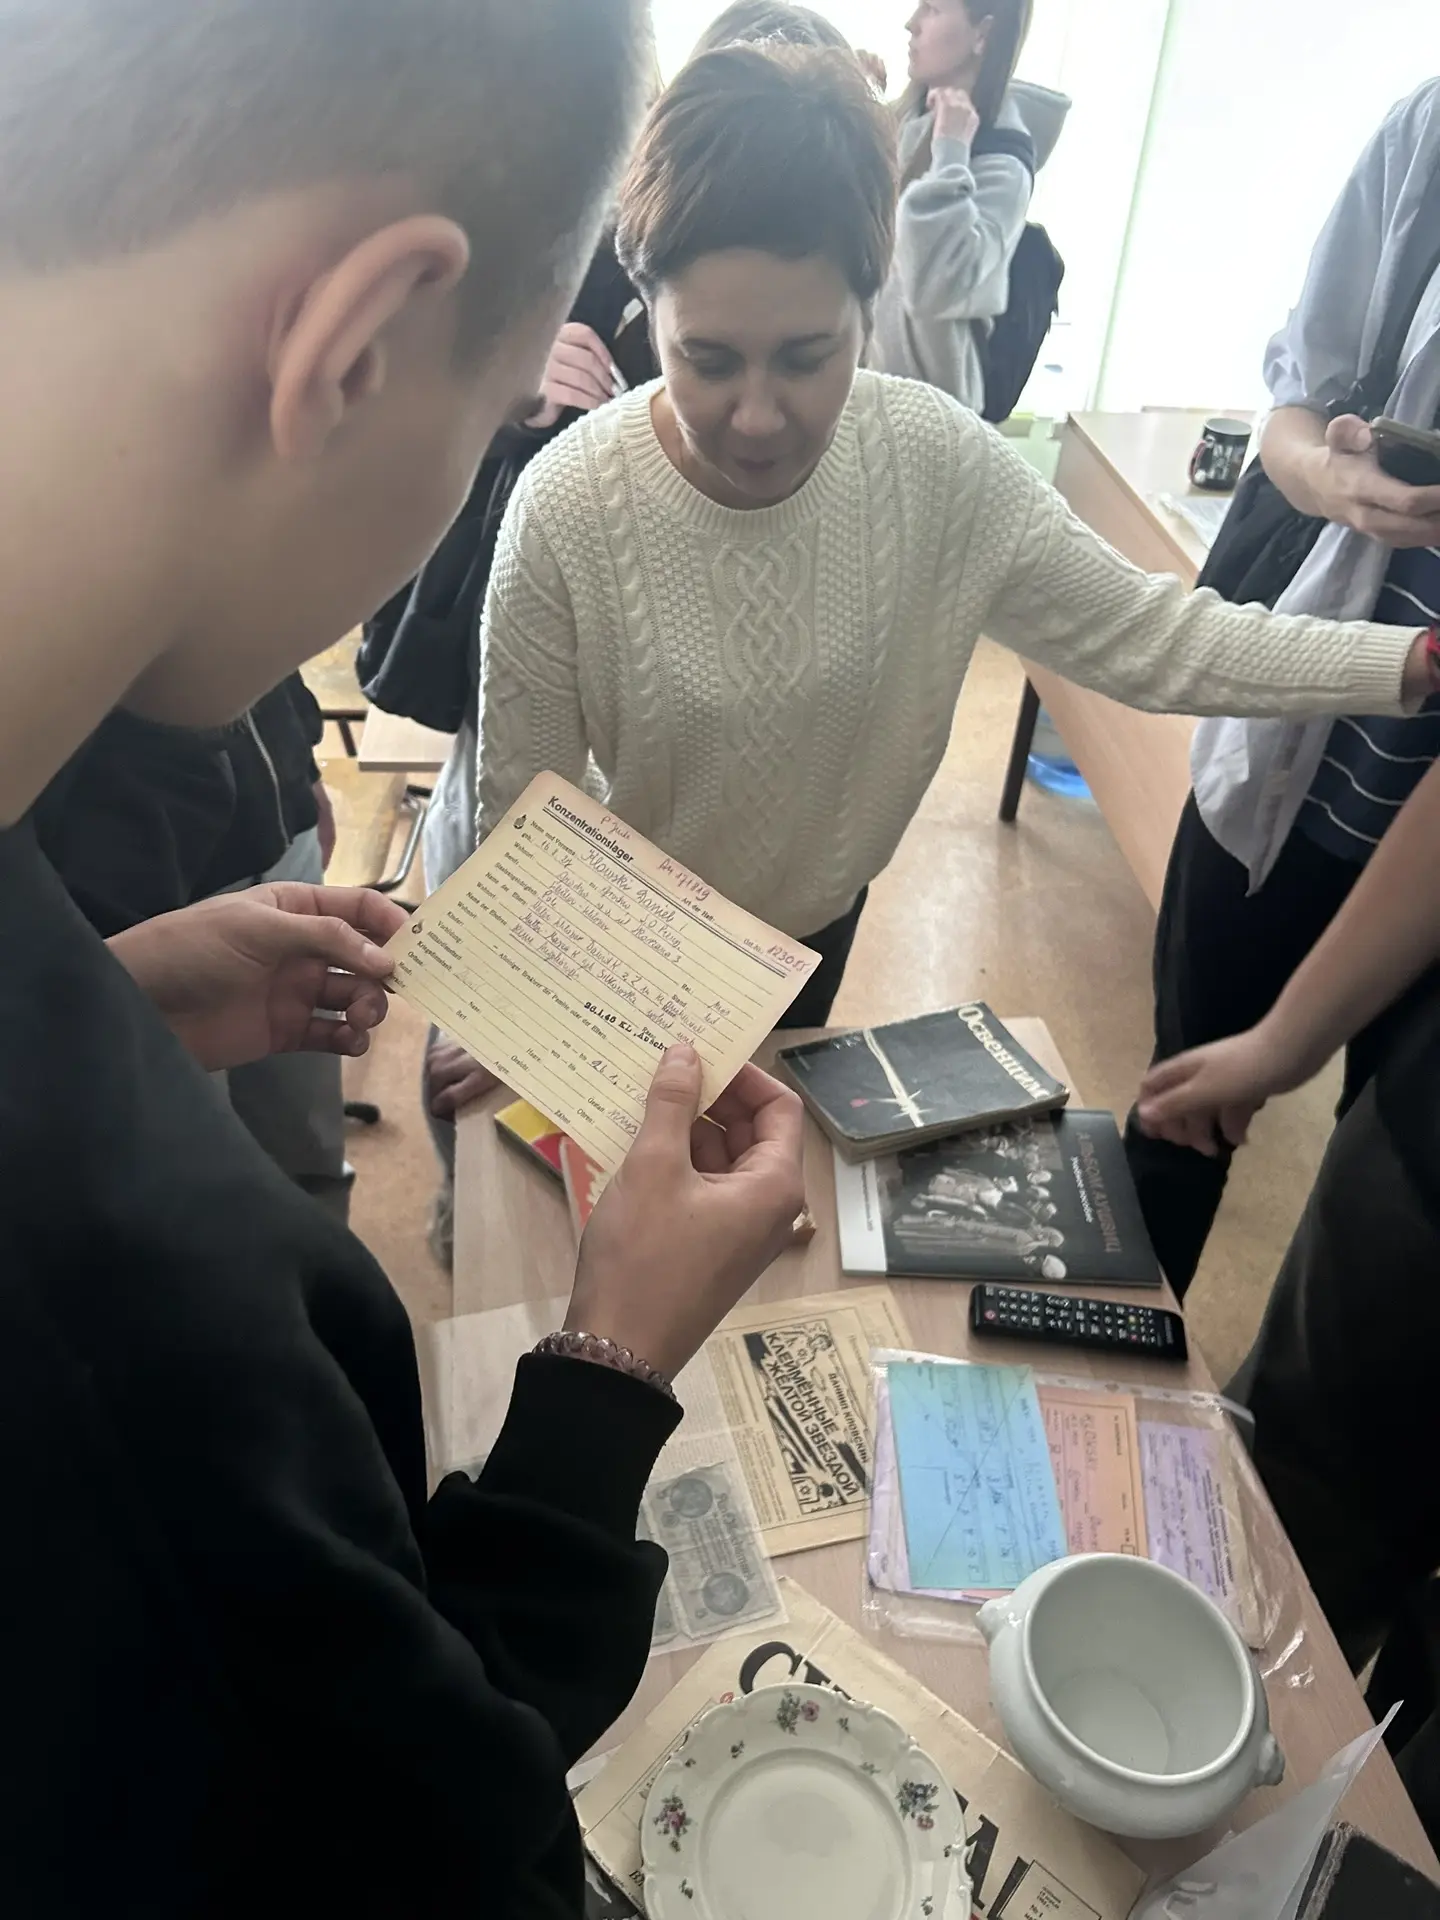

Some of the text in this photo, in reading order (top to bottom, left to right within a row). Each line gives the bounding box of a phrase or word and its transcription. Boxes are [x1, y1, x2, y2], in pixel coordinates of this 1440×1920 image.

[530, 820, 545, 833] Name
[548, 796, 633, 862] Konzentrationslager
[957, 1006, 1050, 1100] Освенцим
[805, 1424, 860, 1497] ЗВЕЗДОЙ
